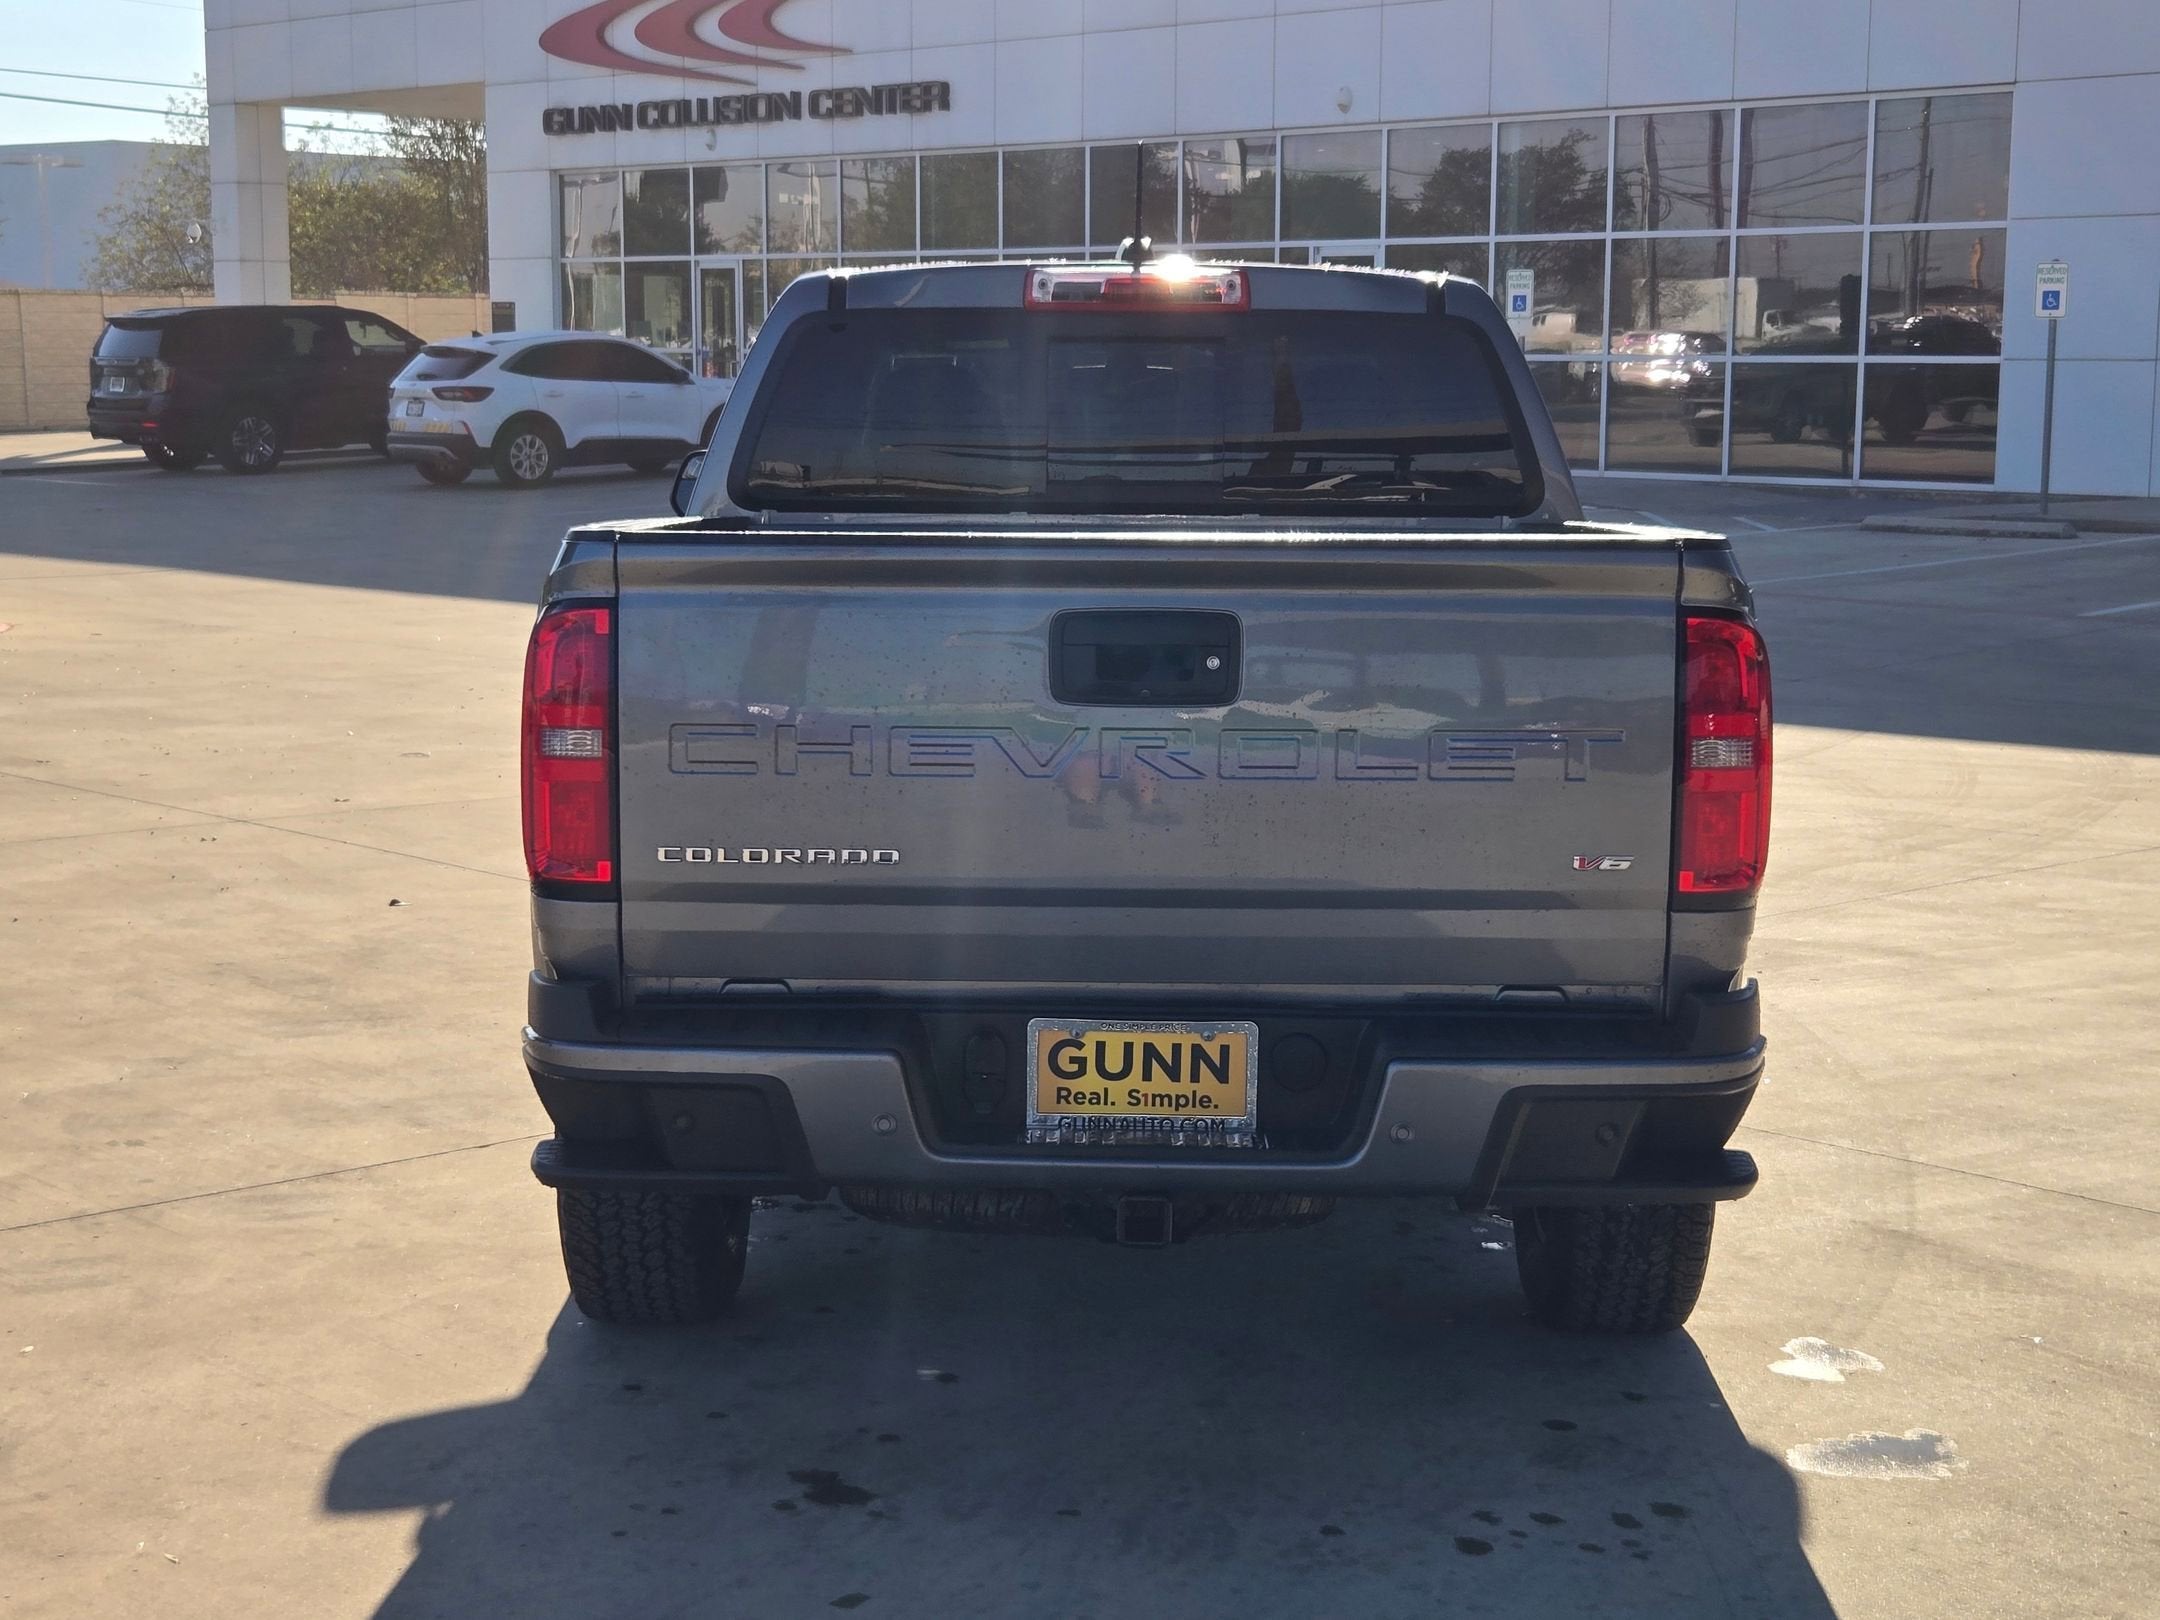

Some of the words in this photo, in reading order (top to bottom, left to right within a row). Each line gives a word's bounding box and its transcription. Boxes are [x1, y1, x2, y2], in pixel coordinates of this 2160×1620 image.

[542, 103, 634, 136] GUNN
[637, 90, 802, 129] COLLISION
[808, 80, 951, 119] CENTER
[2039, 277, 2065, 285] PARKING
[668, 722, 1627, 783] CHEVROLET
[656, 847, 901, 865] COLORADO
[1573, 855, 1635, 871] V6
[1100, 1022, 1121, 1031] ONE
[1123, 1022, 1158, 1033] SIMPLE
[1047, 1038, 1231, 1085] GUNN
[1056, 1086, 1116, 1106] Real.
[1058, 1116, 1226, 1131] GUNNAUTOCOM
